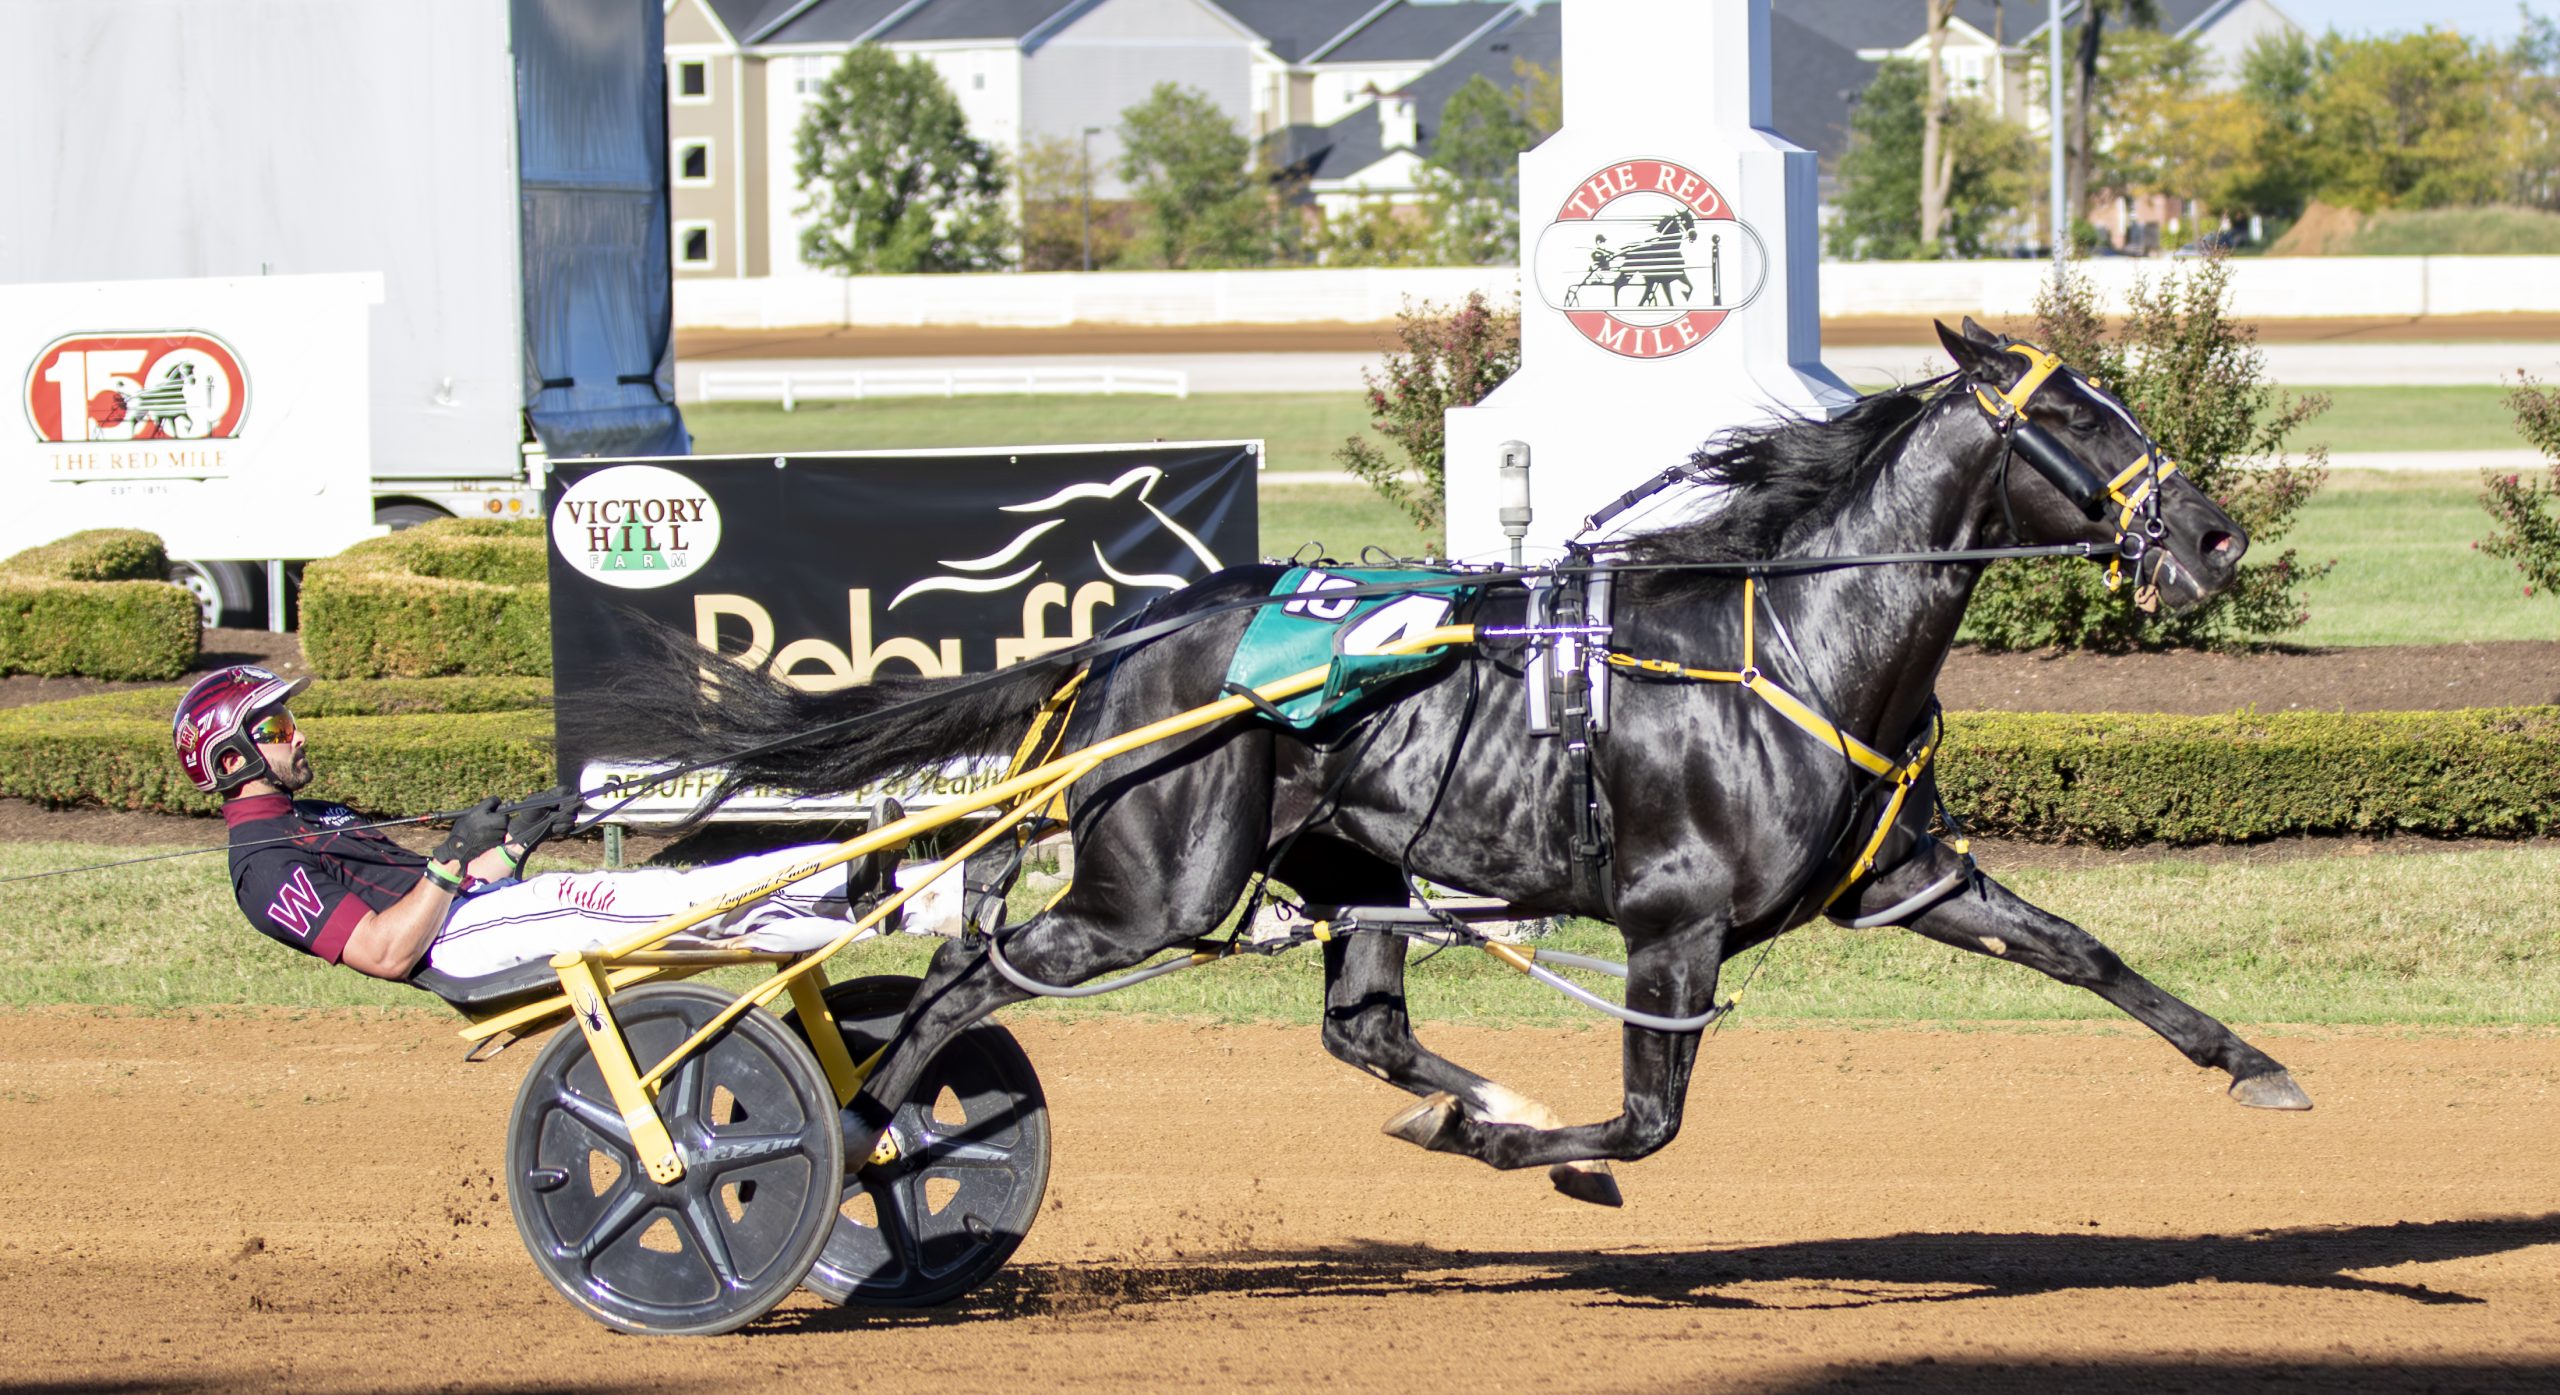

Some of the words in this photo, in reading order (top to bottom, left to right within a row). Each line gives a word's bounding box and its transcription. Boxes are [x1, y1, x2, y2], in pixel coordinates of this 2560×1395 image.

[1568, 165, 1637, 218] THE
[1654, 164, 1720, 216] RED
[1596, 318, 1700, 355] MILE
[44, 348, 231, 441] 150
[50, 453, 98, 471] THE
[110, 451, 158, 470] RED
[168, 451, 228, 469] MILE
[564, 498, 706, 524] VICTORY
[586, 525, 689, 552] HILL
[589, 553, 687, 569] FARM
[1343, 594, 1450, 656] 4
[267, 866, 325, 938] W
